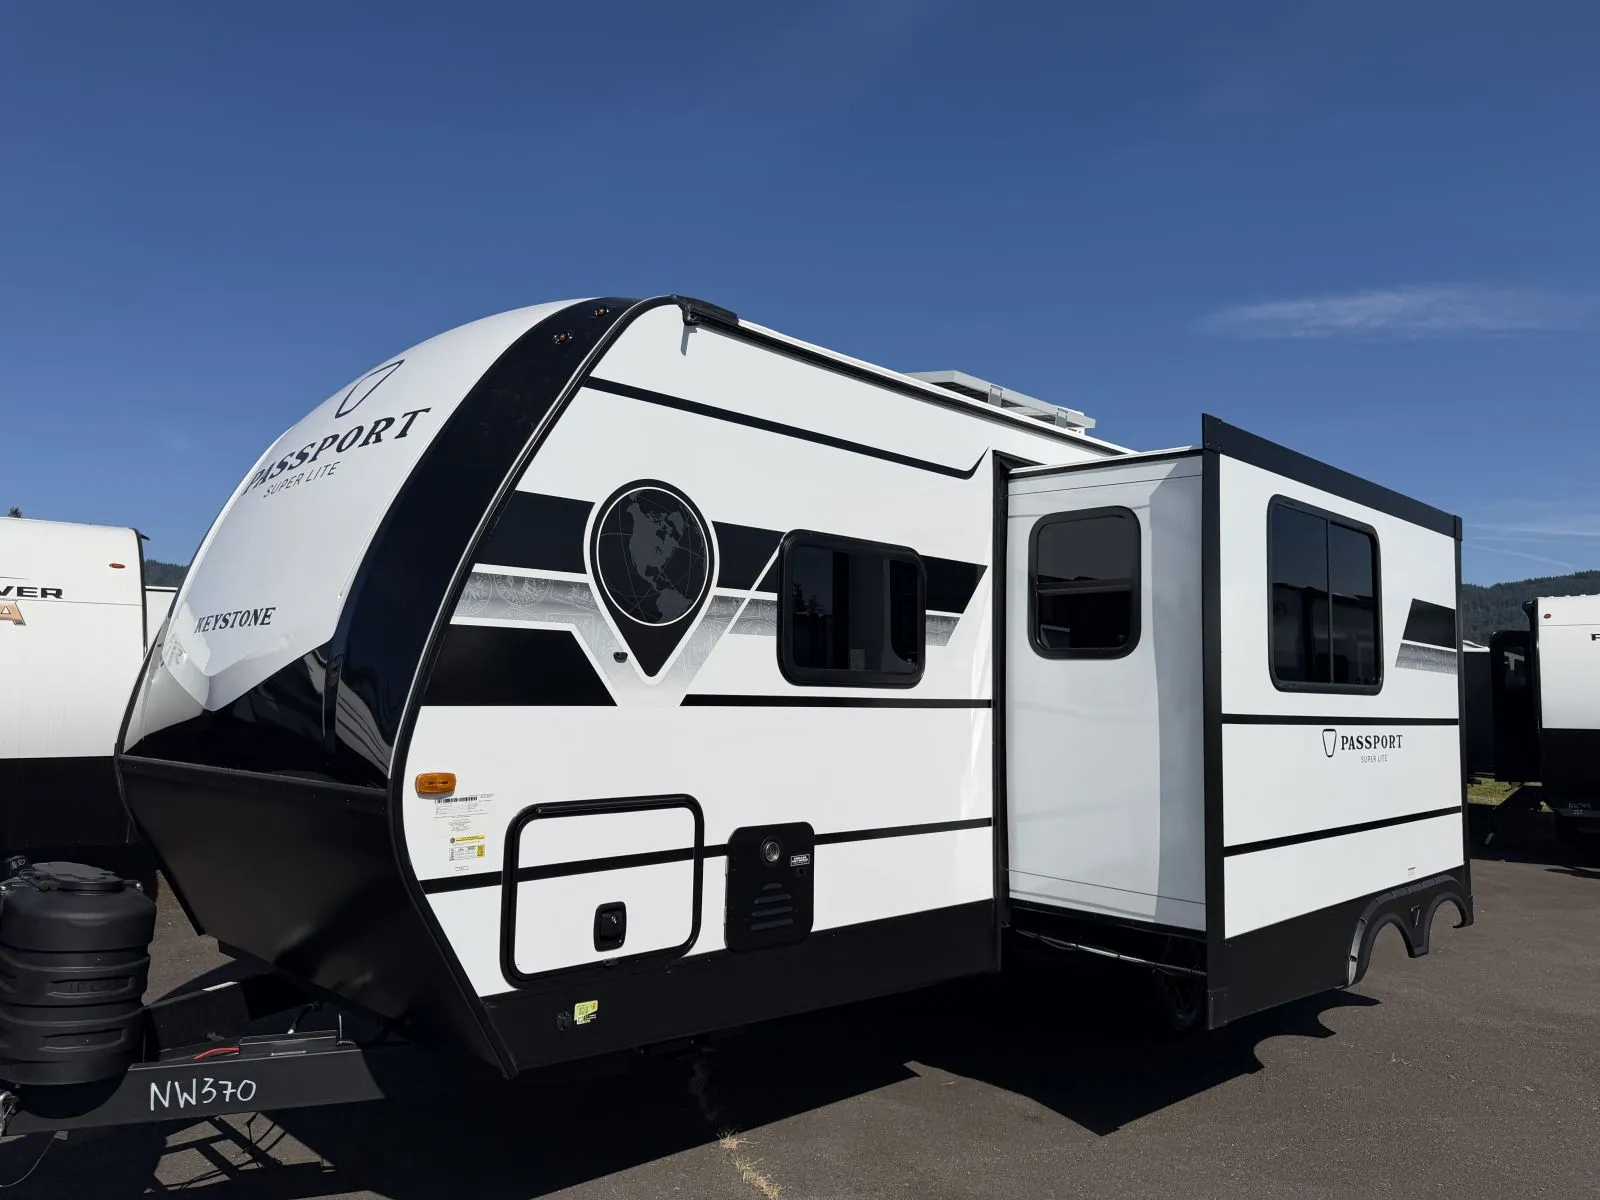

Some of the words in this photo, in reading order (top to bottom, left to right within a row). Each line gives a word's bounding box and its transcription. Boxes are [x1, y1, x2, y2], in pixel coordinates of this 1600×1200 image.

[241, 407, 432, 496] PASSPORT
[263, 473, 305, 498] SUPER
[305, 461, 341, 482] LITE
[194, 607, 276, 633] KEYSTONE
[1340, 734, 1403, 751] PASSPORT
[1360, 755, 1377, 764] SUPER
[1377, 754, 1388, 763] LITE
[150, 1077, 257, 1112] NW370
